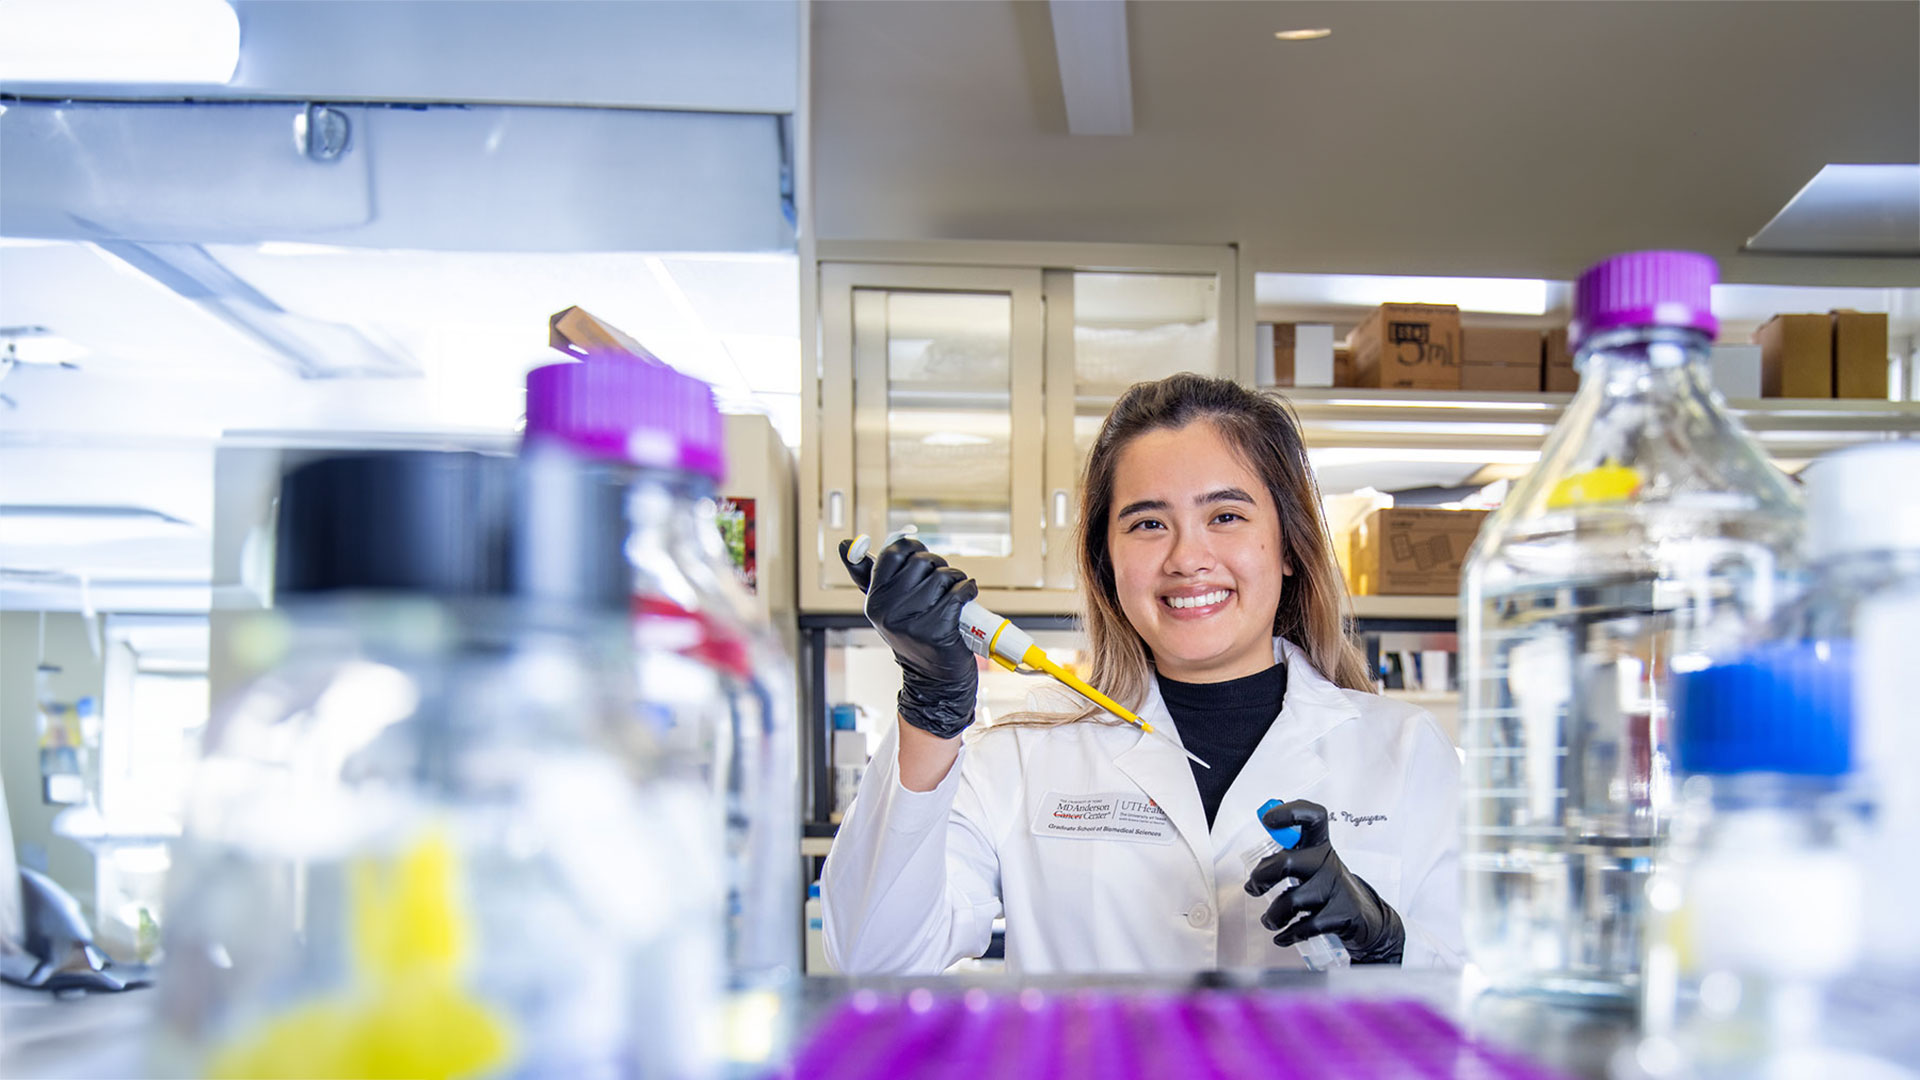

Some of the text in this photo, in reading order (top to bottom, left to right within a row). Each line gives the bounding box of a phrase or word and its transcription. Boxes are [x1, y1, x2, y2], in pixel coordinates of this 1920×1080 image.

[1048, 823, 1076, 832] Graduate
[1103, 825, 1135, 834] Biomedical
[1135, 829, 1162, 837] Sciences
